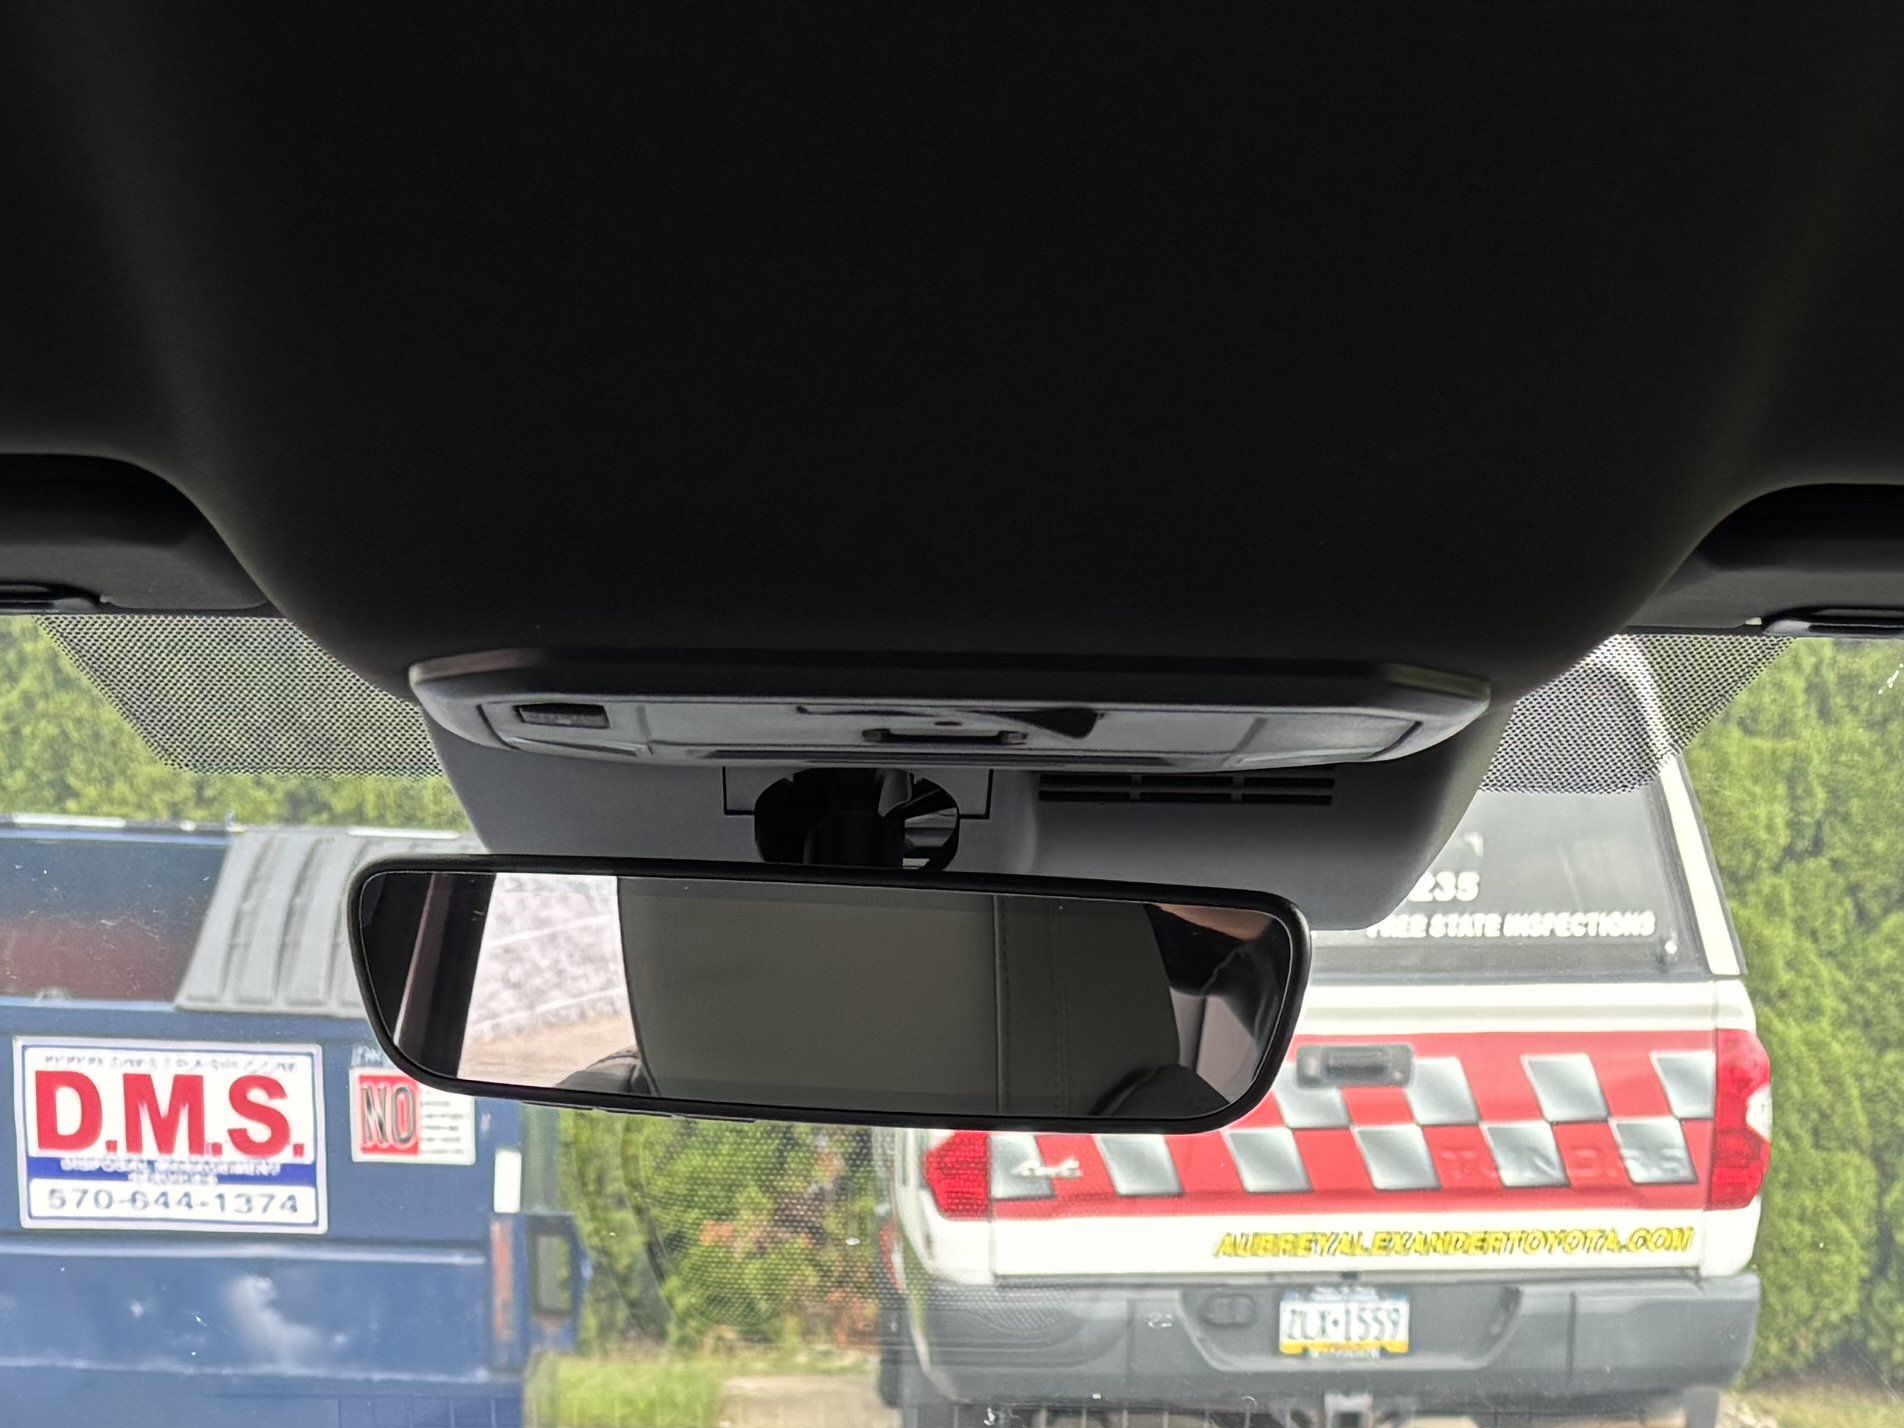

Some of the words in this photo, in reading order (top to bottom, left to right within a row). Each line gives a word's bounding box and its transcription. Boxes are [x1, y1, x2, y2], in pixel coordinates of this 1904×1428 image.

[1430, 913, 1501, 938] STATE
[1503, 911, 1656, 938] INSPECTIONS
[35, 1070, 305, 1159] D.M.S.
[360, 1083, 417, 1148] NO
[48, 1188, 300, 1214] 570-644-1374
[1214, 1226, 1695, 1258] AUBREYALEXANDERTOYOTA.COM
